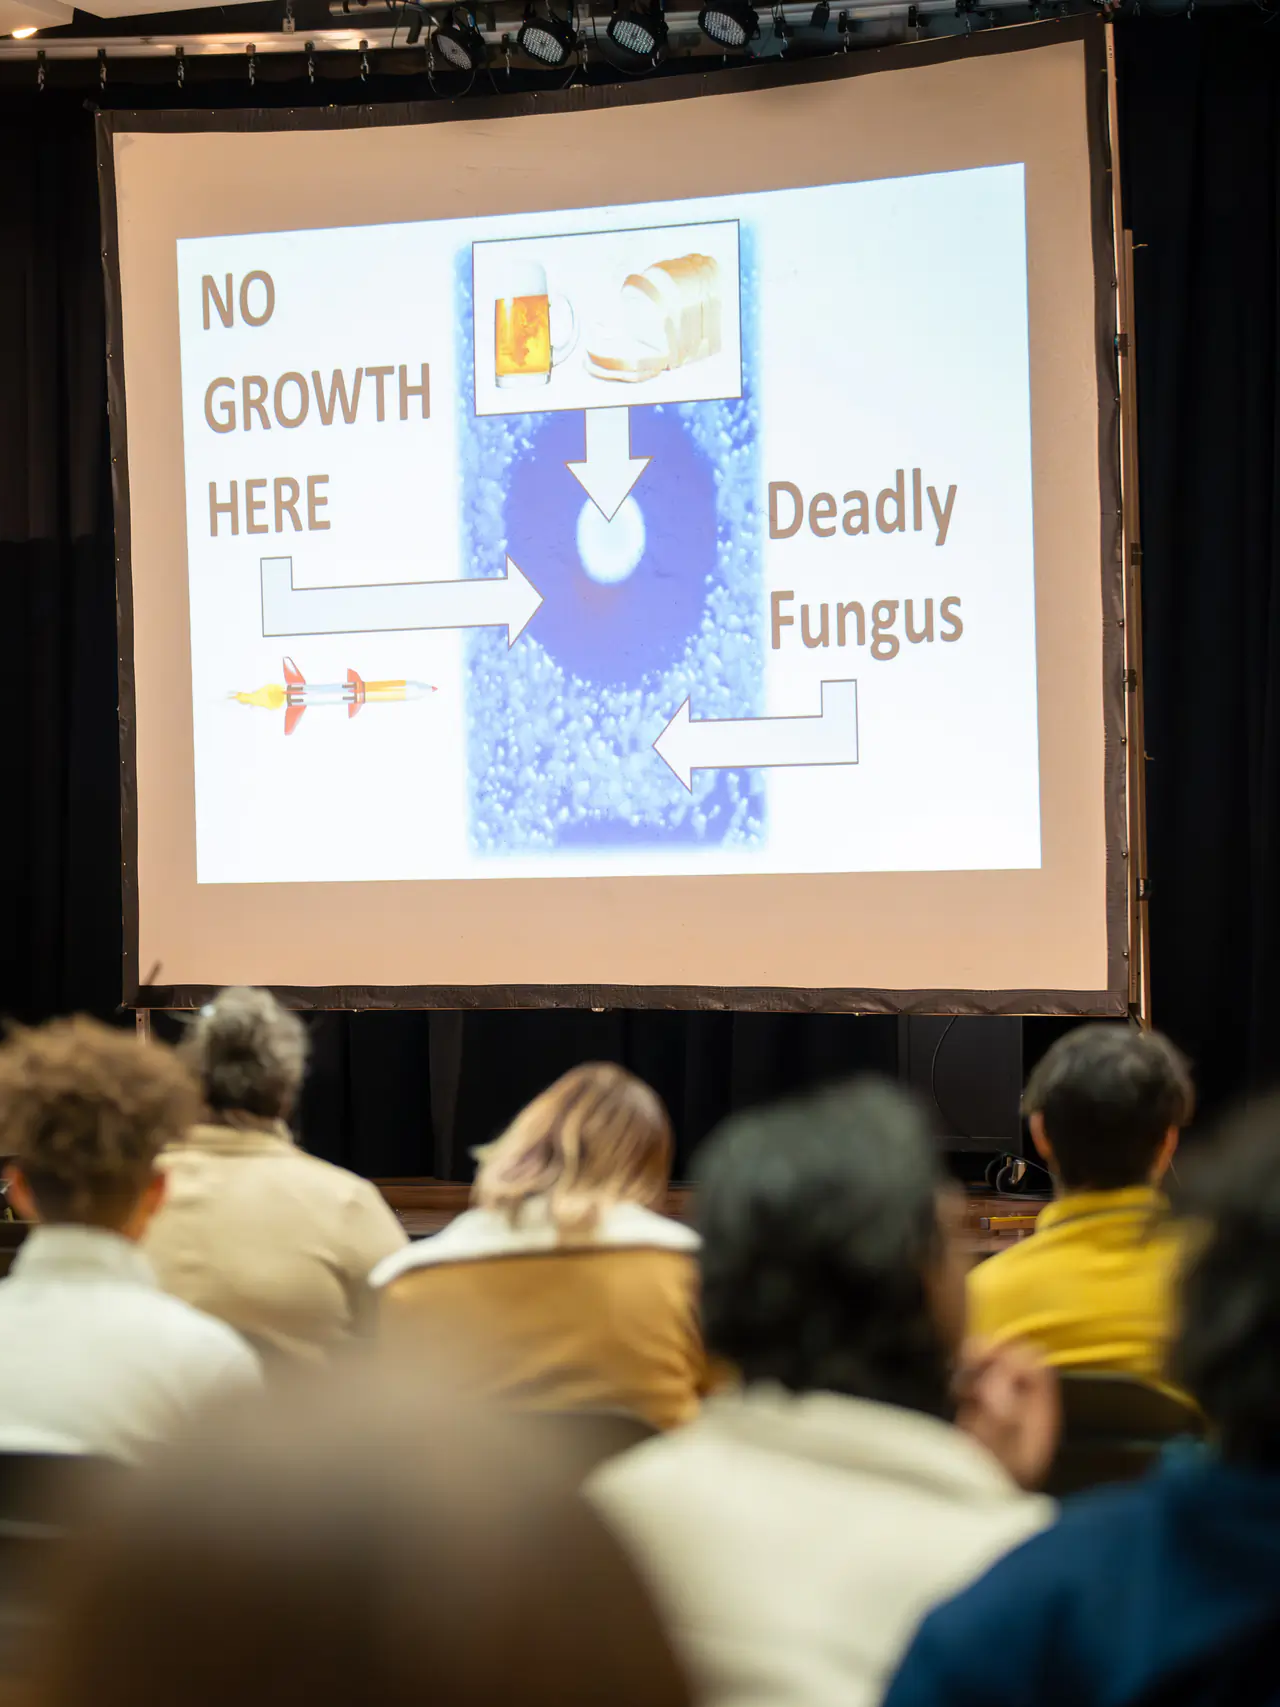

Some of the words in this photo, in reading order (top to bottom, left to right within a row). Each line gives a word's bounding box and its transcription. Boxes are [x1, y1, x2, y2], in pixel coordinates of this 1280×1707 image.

[201, 270, 276, 330] NO
[204, 363, 431, 434] GROWTH
[208, 474, 331, 537] HERE
[767, 467, 958, 547] Deadly
[770, 590, 964, 661] Fungus
